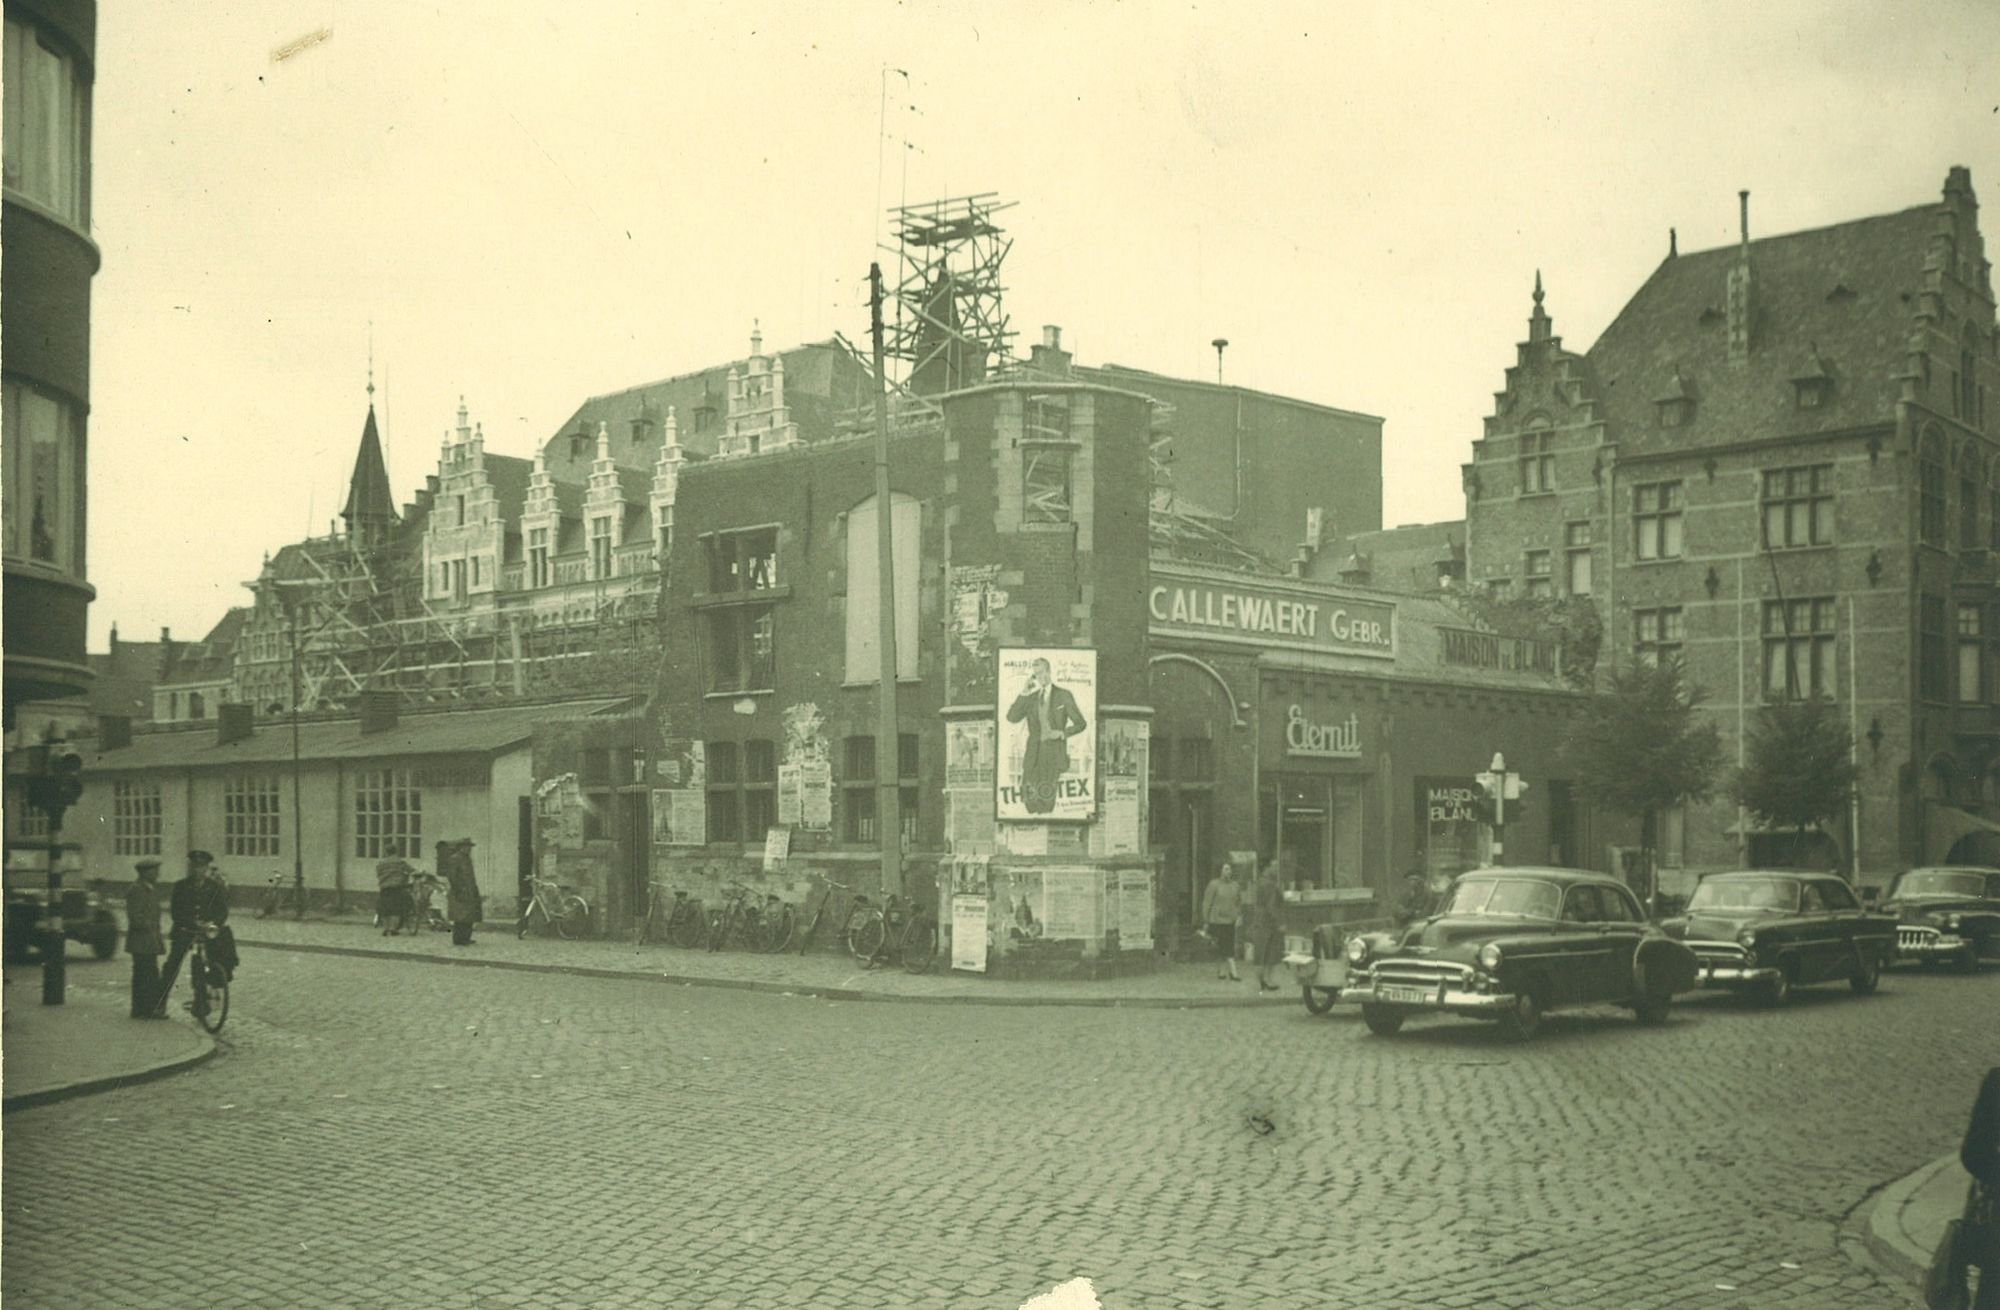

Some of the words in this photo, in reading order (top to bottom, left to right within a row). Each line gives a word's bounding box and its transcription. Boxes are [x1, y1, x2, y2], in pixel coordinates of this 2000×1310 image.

[1149, 585, 1318, 637] CALLEWAERT
[1445, 630, 1499, 670] MAISON
[1286, 703, 1362, 751] Eternit
